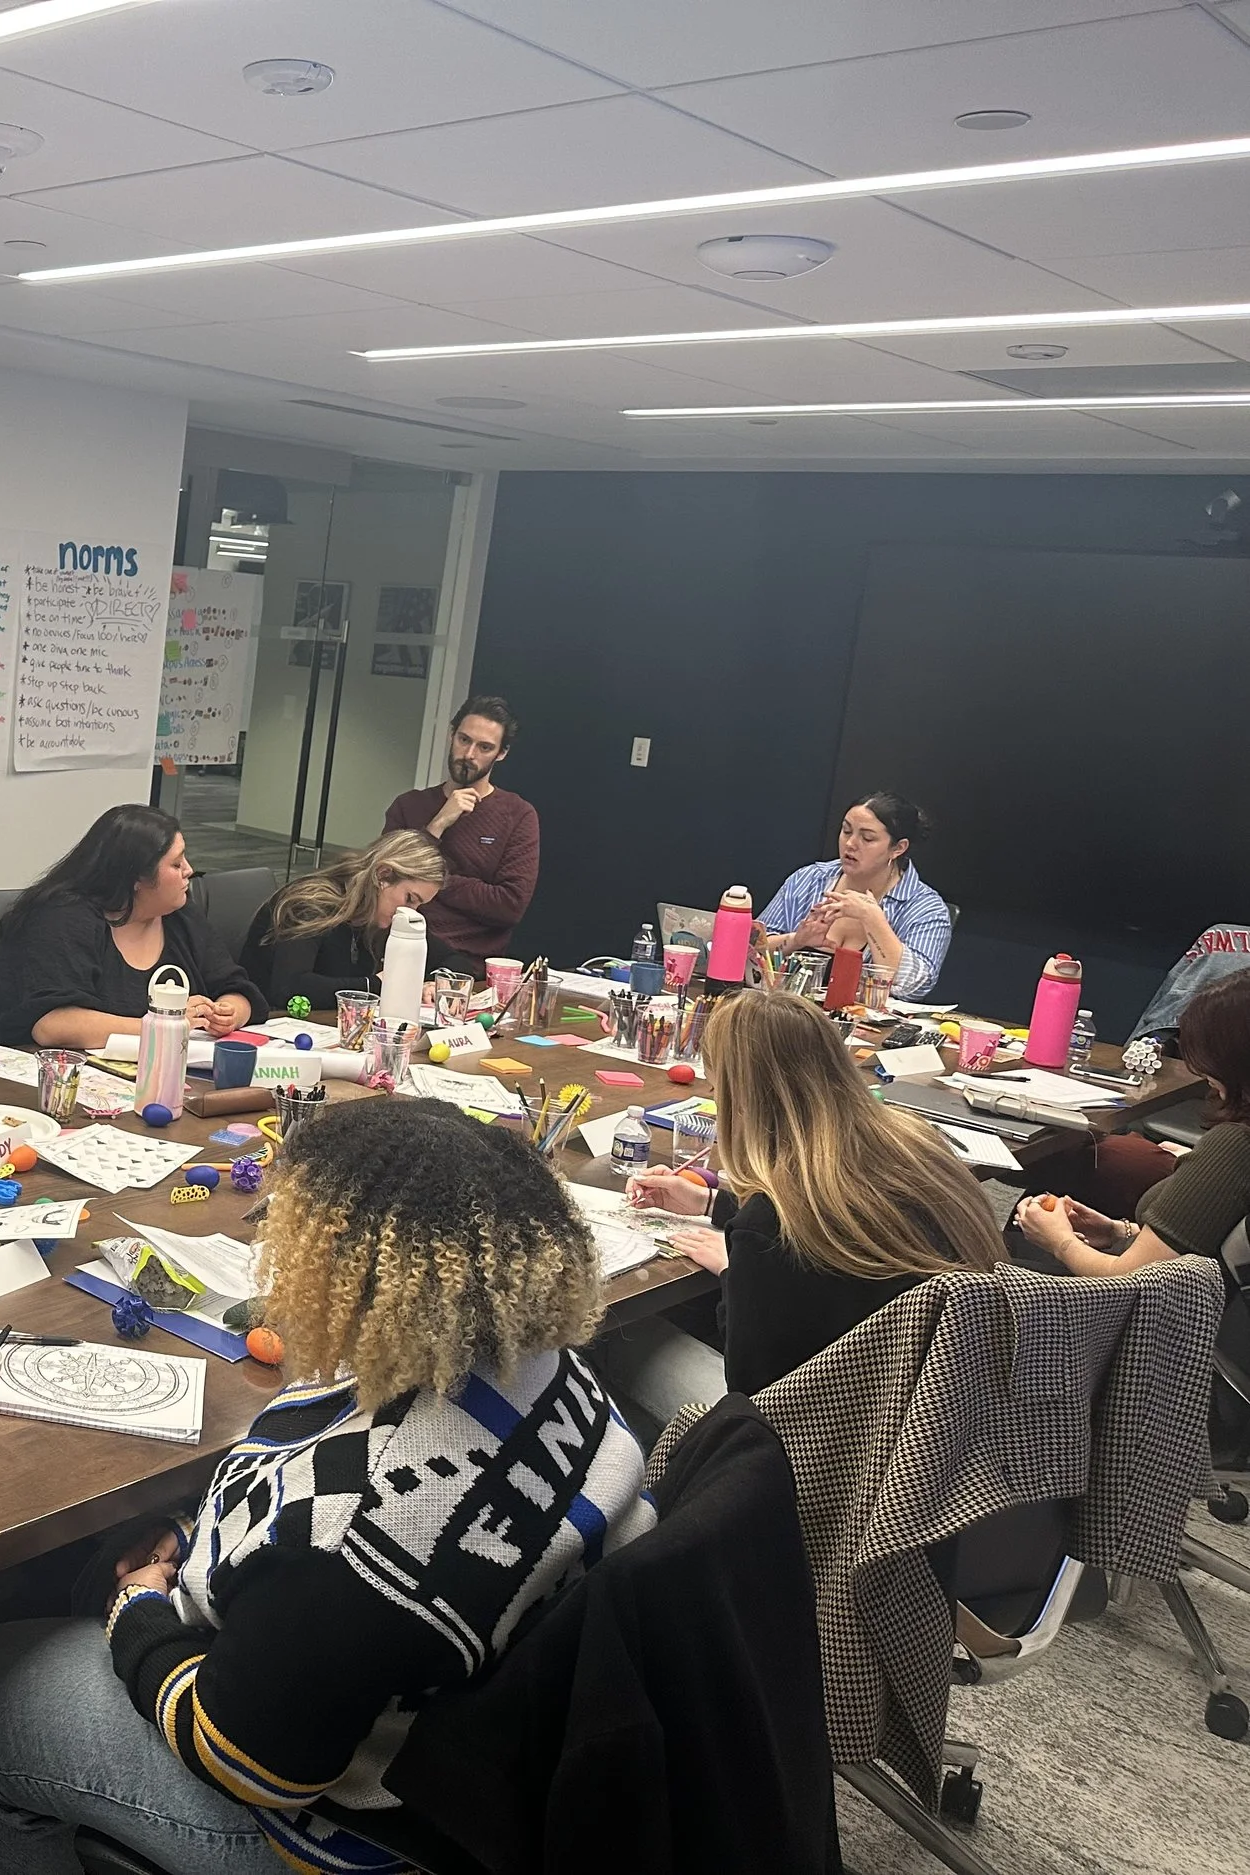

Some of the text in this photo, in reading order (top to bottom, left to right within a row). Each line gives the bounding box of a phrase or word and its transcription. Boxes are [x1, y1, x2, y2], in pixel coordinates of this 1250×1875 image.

[58, 541, 139, 577] norms
[0, 564, 10, 572] of
[35, 576, 48, 592] be
[33, 597, 76, 611] participate
[34, 611, 83, 625] be on time
[32, 625, 42, 636] no
[32, 643, 47, 652] one
[70, 647, 87, 656] one
[30, 658, 46, 672] give
[49, 660, 72, 674] people
[93, 662, 102, 674] to
[105, 662, 132, 677] think
[47, 680, 58, 693] up
[82, 681, 108, 695] back
[27, 696, 43, 708] ask
[55, 713, 71, 727] best
[73, 719, 116, 732] intentions
[26, 733, 35, 749] be
[442, 1035, 473, 1049] AURA
